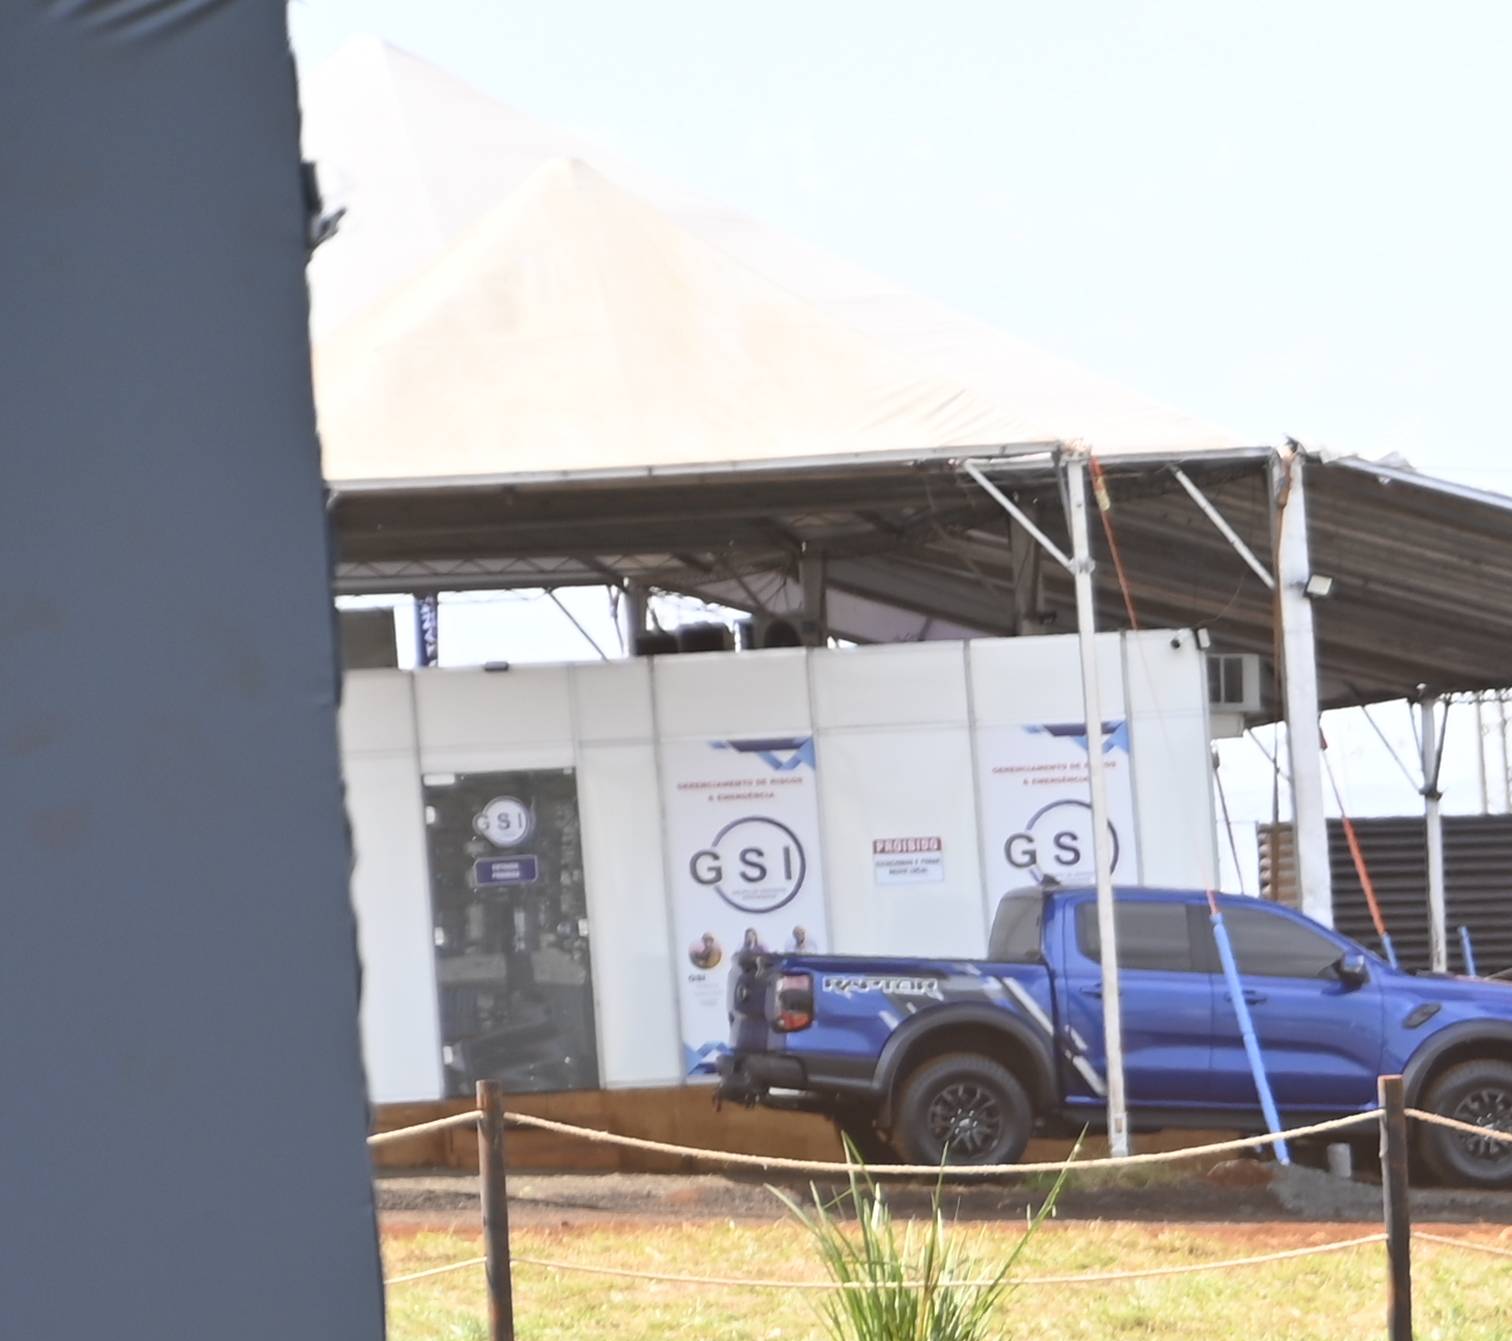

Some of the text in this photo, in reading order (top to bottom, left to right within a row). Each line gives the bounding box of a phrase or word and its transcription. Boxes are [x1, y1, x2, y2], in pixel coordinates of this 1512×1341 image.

[689, 845, 792, 885] GSI
[1004, 831, 1090, 869] GS
[822, 975, 944, 1001] RAPTOR
